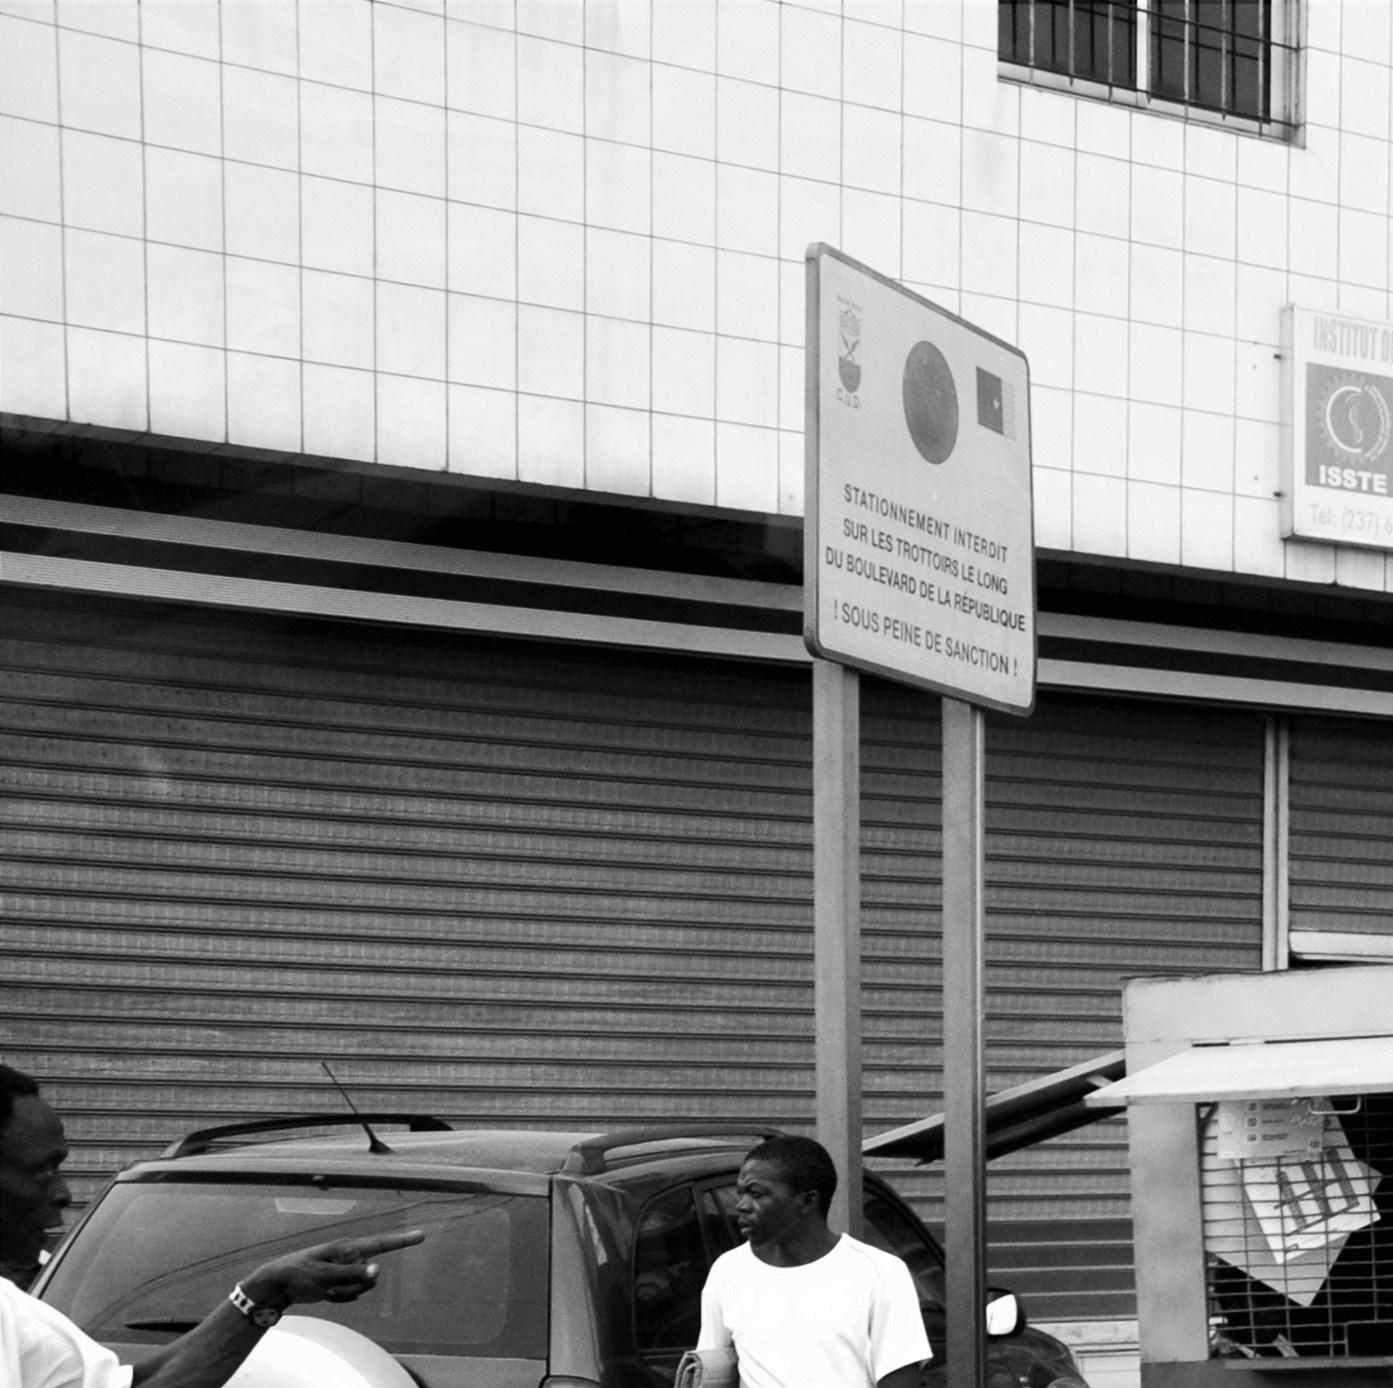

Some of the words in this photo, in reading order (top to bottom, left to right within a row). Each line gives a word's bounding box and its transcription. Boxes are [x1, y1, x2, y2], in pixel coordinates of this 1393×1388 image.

[1313, 316, 1378, 360] INSTITUT
[1319, 465, 1388, 494] ISSTE
[843, 518, 869, 546] SUR
[872, 529, 893, 555] LES
[896, 538, 959, 578] TROTTOIRS
[962, 561, 974, 584] LE
[977, 567, 1007, 596] LONG
[844, 484, 949, 542] STATIONNEMENT
[954, 525, 1007, 564] INTERDIT
[1342, 509, 1379, 537] (237)
[826, 546, 842, 570] DU
[847, 553, 916, 595] BOULEVARD
[920, 578, 934, 601] DE
[938, 584, 951, 607] LA
[955, 590, 1025, 632] RÉPUBLIQUE
[842, 603, 879, 633] SOUS
[884, 616, 921, 647] PEINE
[925, 629, 941, 653] DE
[945, 635, 1009, 675] SANCTION
